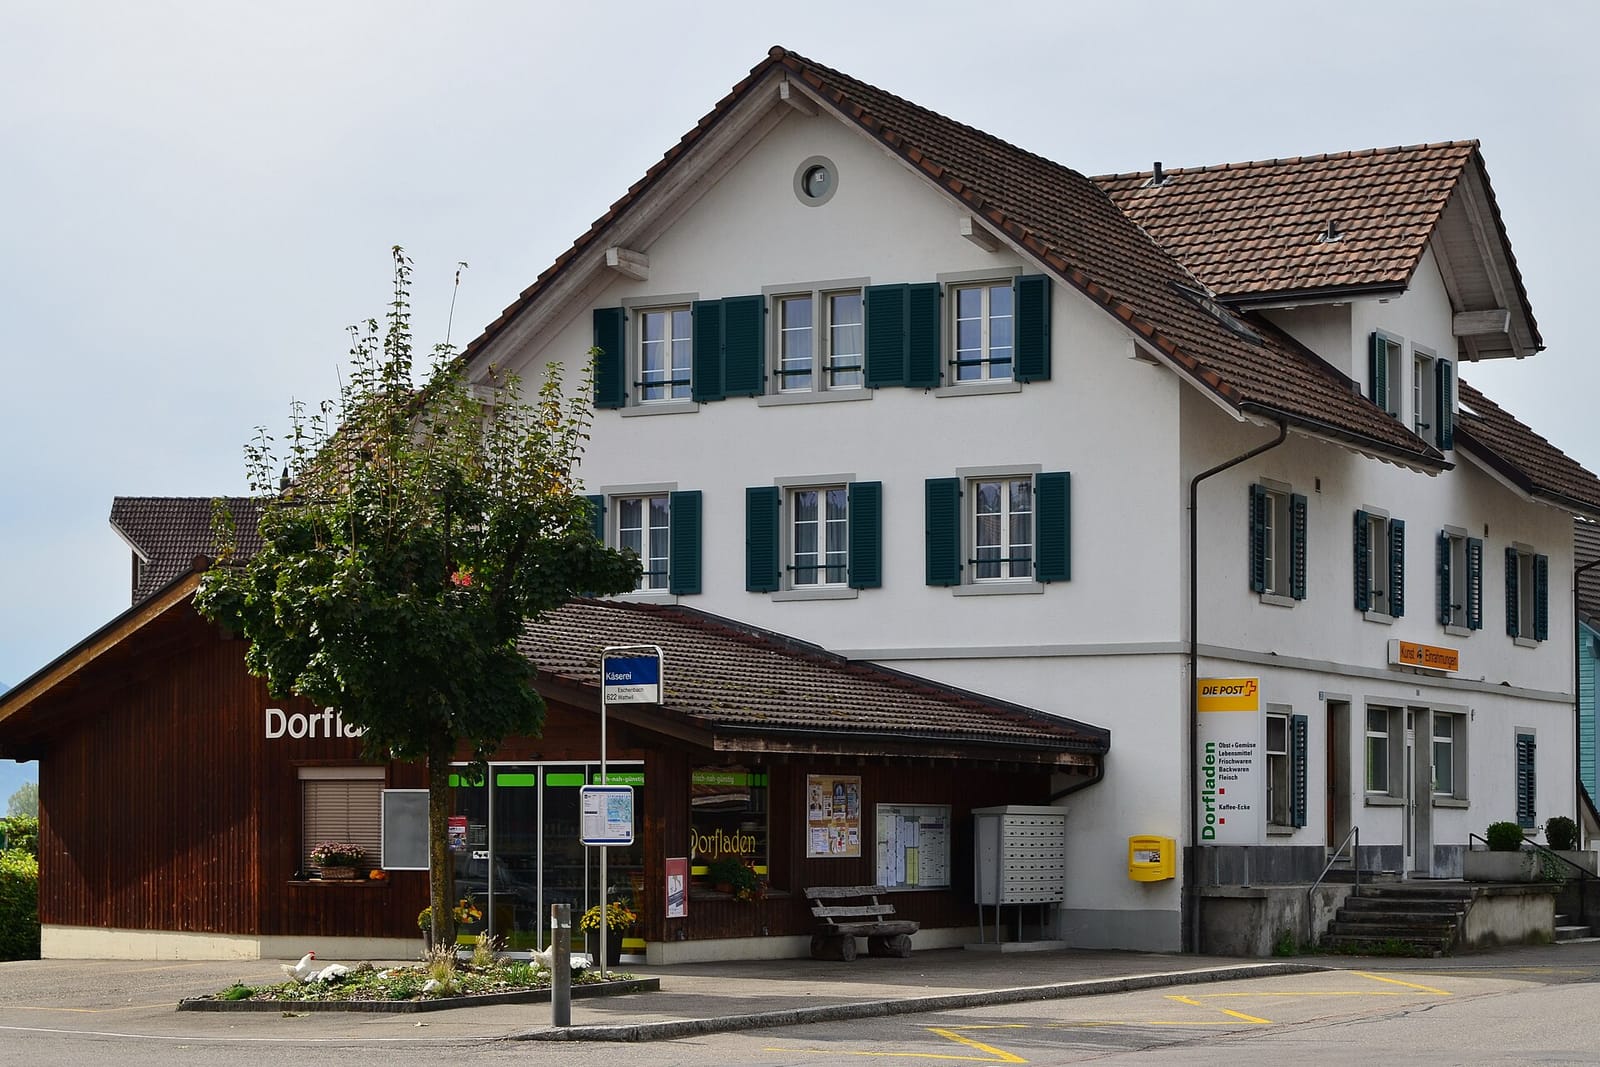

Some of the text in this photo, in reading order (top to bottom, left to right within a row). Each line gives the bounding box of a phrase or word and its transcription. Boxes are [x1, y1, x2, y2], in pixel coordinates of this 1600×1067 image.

[606, 672, 632, 680] Käserei
[1202, 685, 1244, 695] DIE POST
[606, 693, 618, 701] 622
[265, 706, 370, 739] Dorfla
[1202, 742, 1216, 840] Dorfladen
